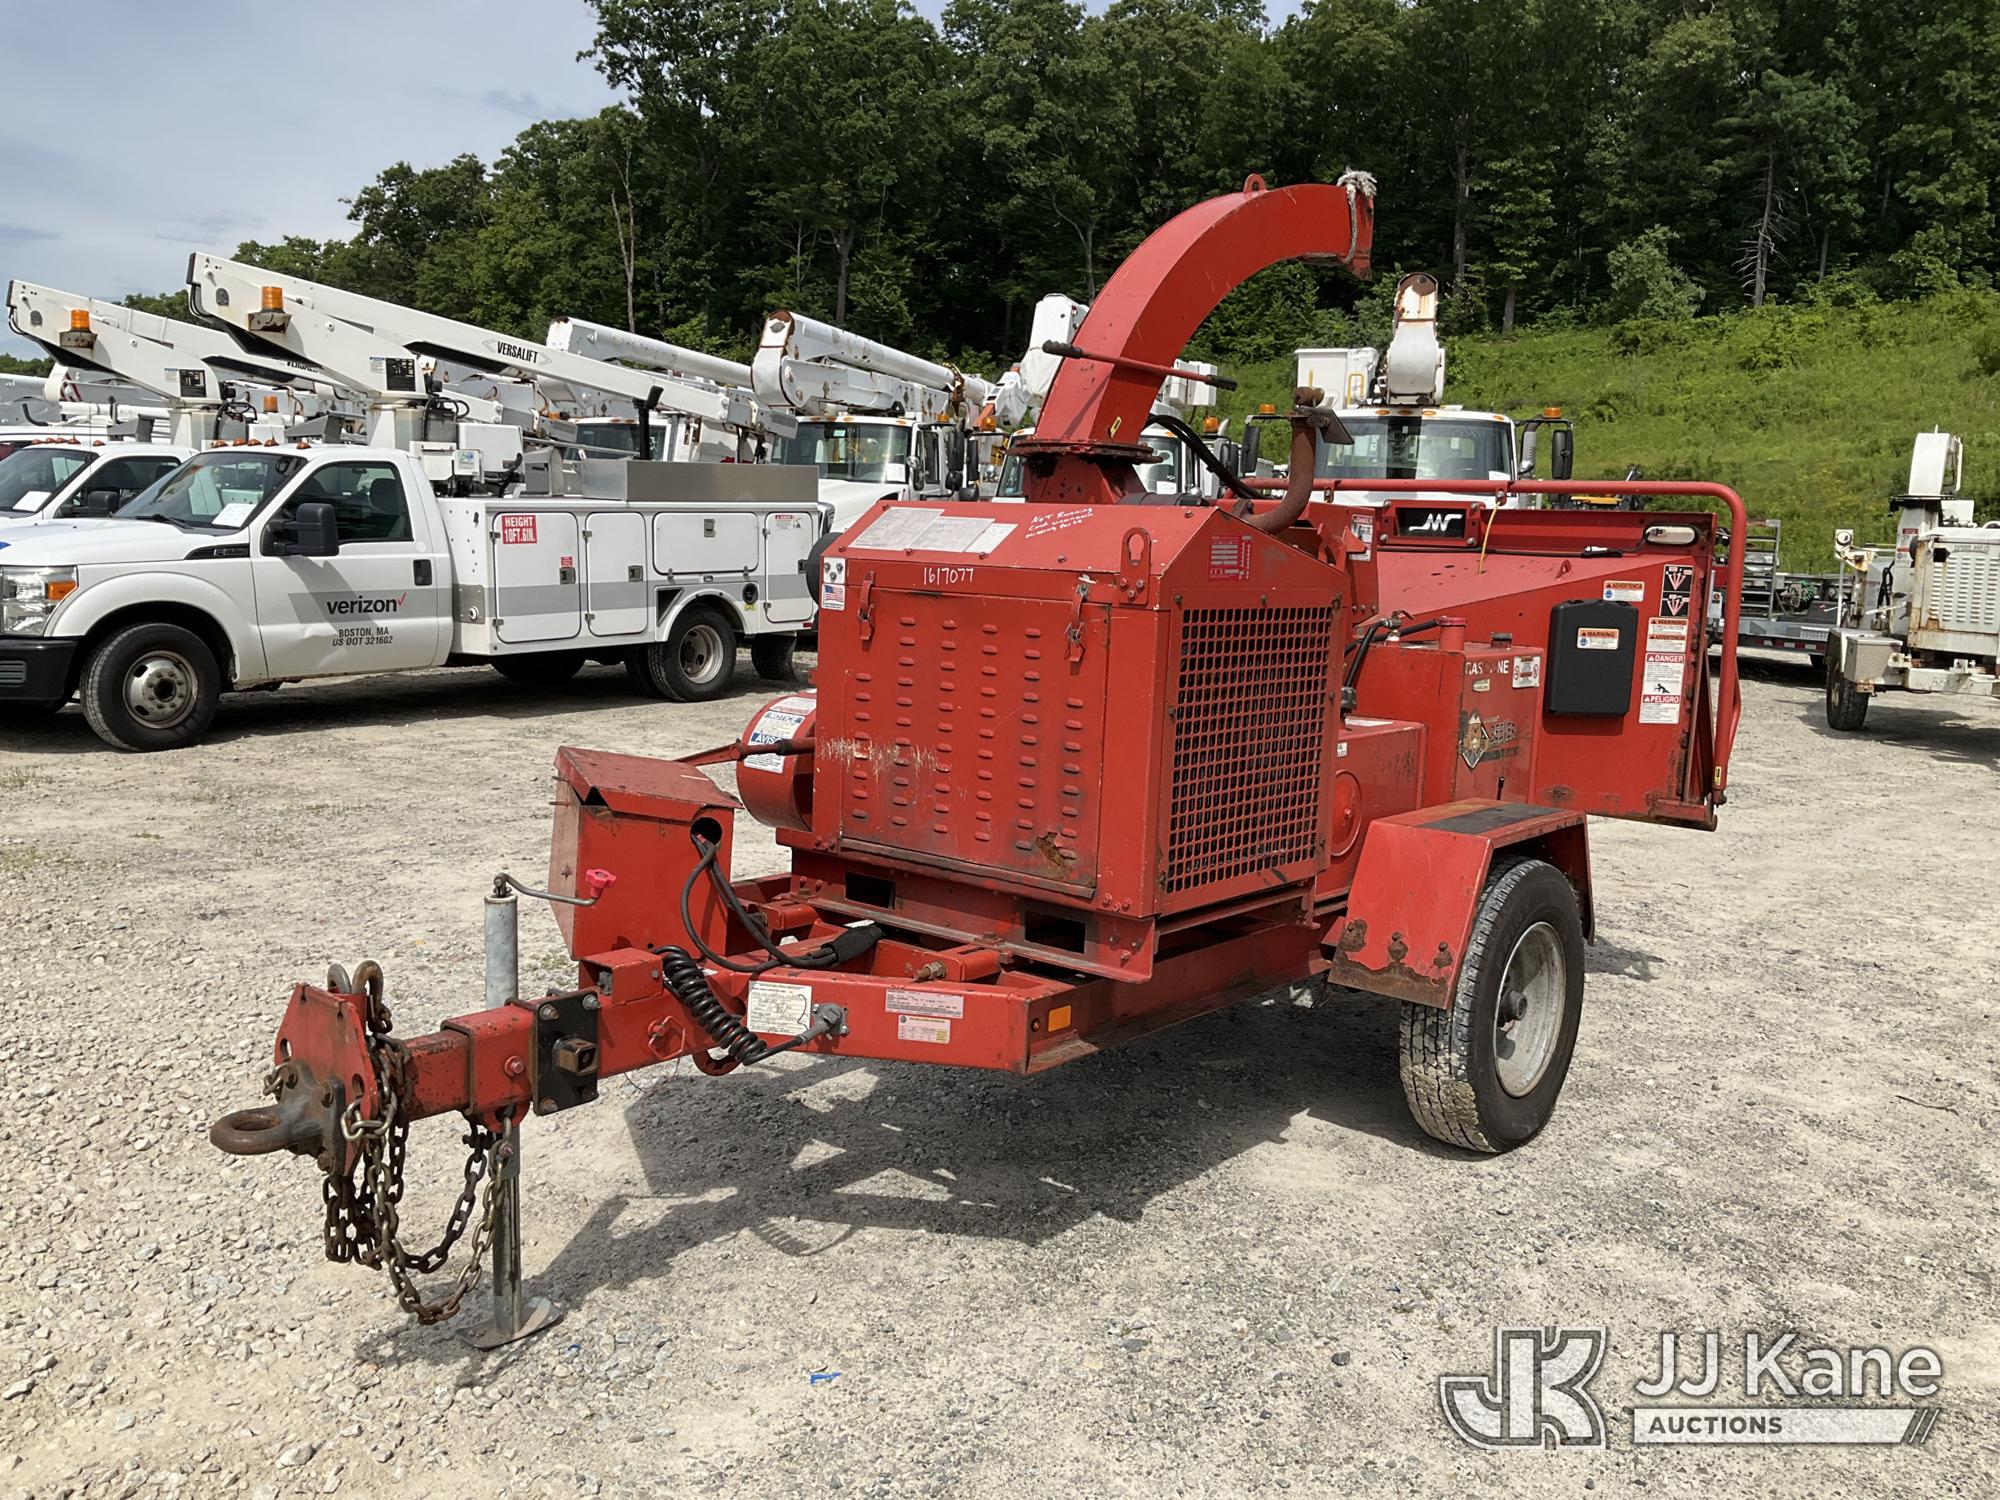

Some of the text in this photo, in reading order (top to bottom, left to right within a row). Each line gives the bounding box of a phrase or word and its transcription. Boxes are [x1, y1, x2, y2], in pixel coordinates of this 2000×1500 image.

[497, 341, 539, 363] VERSALIFT
[504, 516, 534, 527] HEIGHT
[923, 566, 974, 586] 1617077
[326, 594, 398, 615] verizon
[338, 627, 390, 638] BOSTON, MA
[332, 637, 344, 647] US
[346, 635, 364, 646] DOT
[1654, 654, 1684, 663] DANGER
[1650, 695, 1680, 704] PELIGRO
